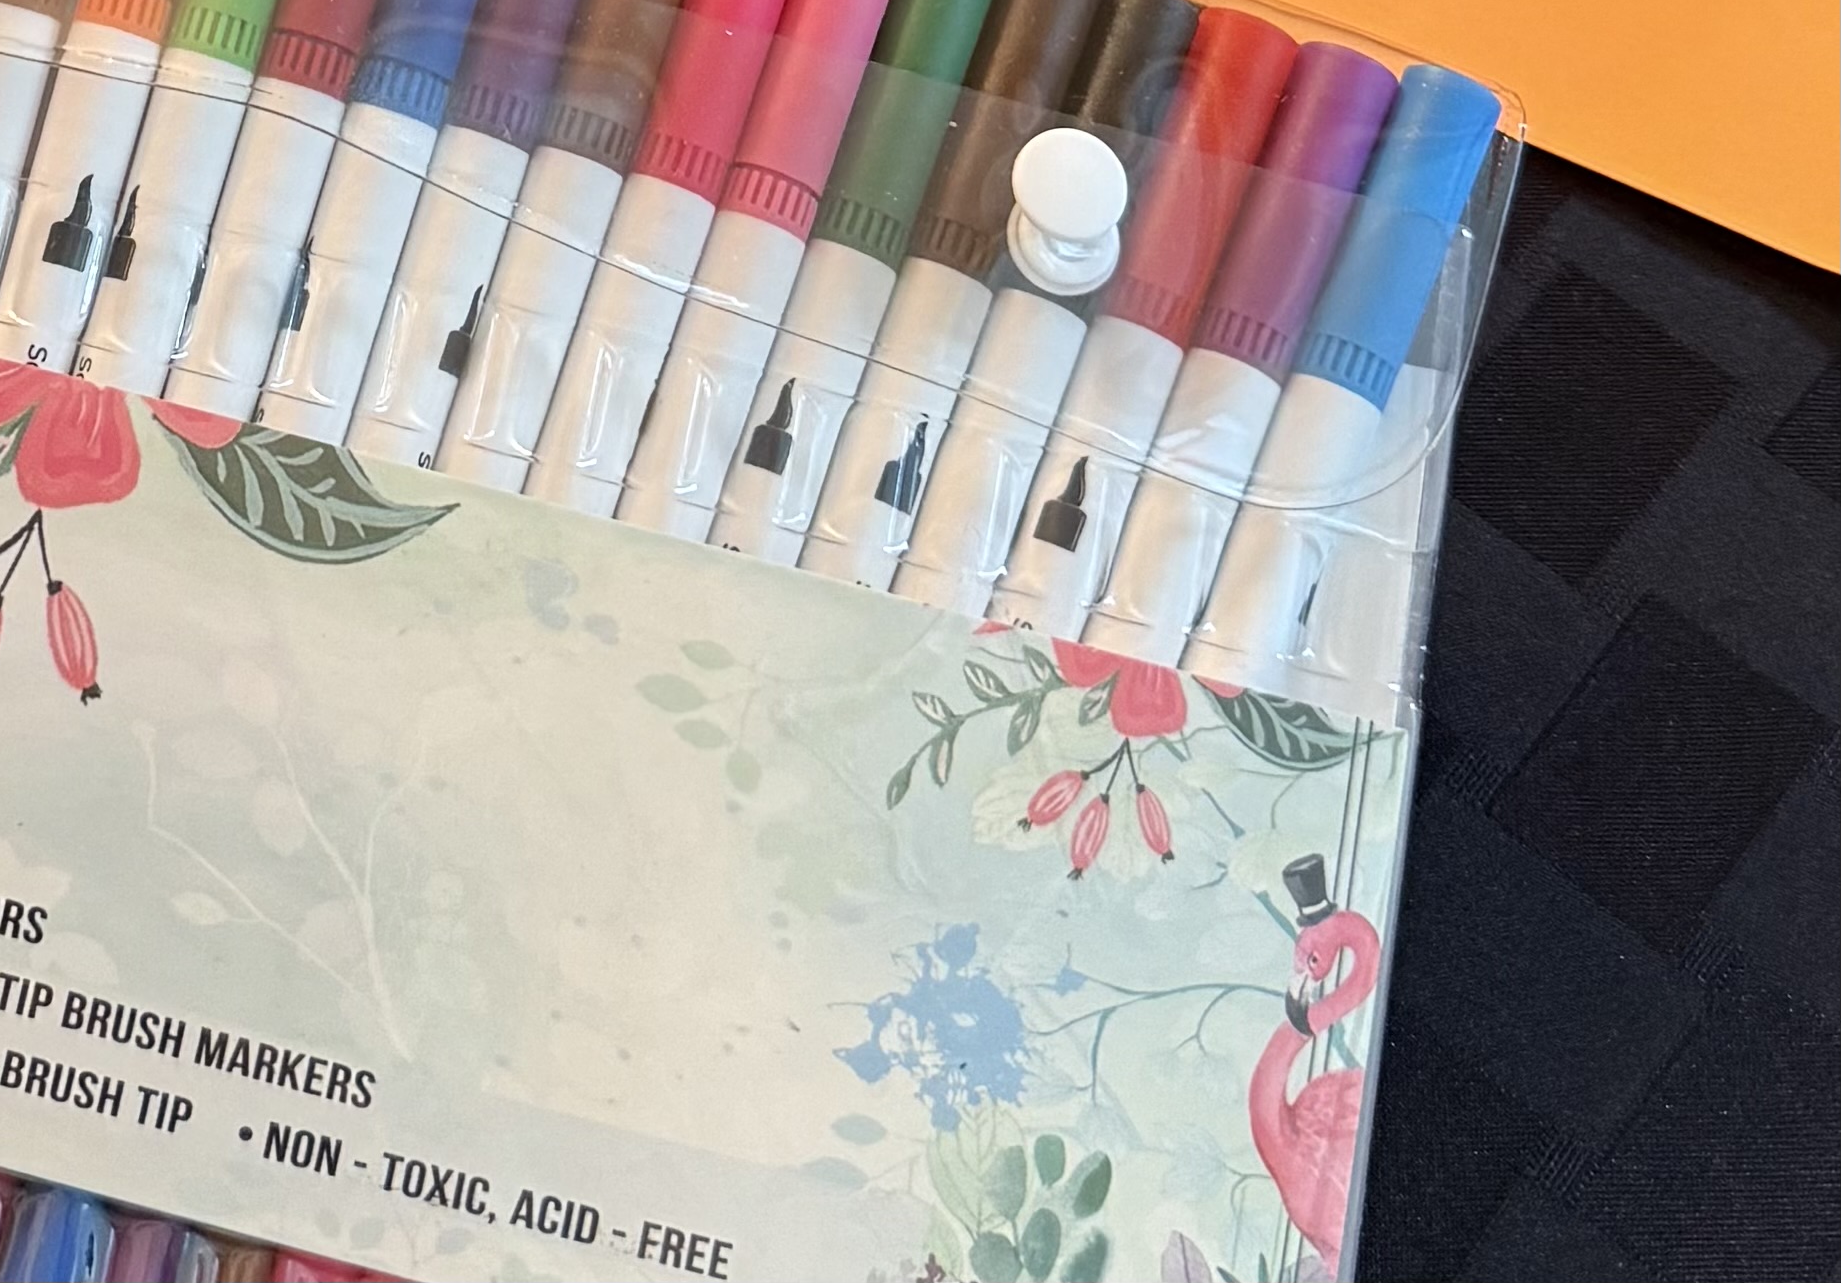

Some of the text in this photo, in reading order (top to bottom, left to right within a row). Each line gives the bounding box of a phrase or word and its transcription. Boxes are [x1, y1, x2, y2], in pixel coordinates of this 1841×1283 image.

[60, 990, 188, 1060] BRUSH
[193, 1025, 378, 1111] MARKERS
[137, 1084, 195, 1135] TIP
[262, 1120, 734, 1282] NON TOXIC, ACID FREE
